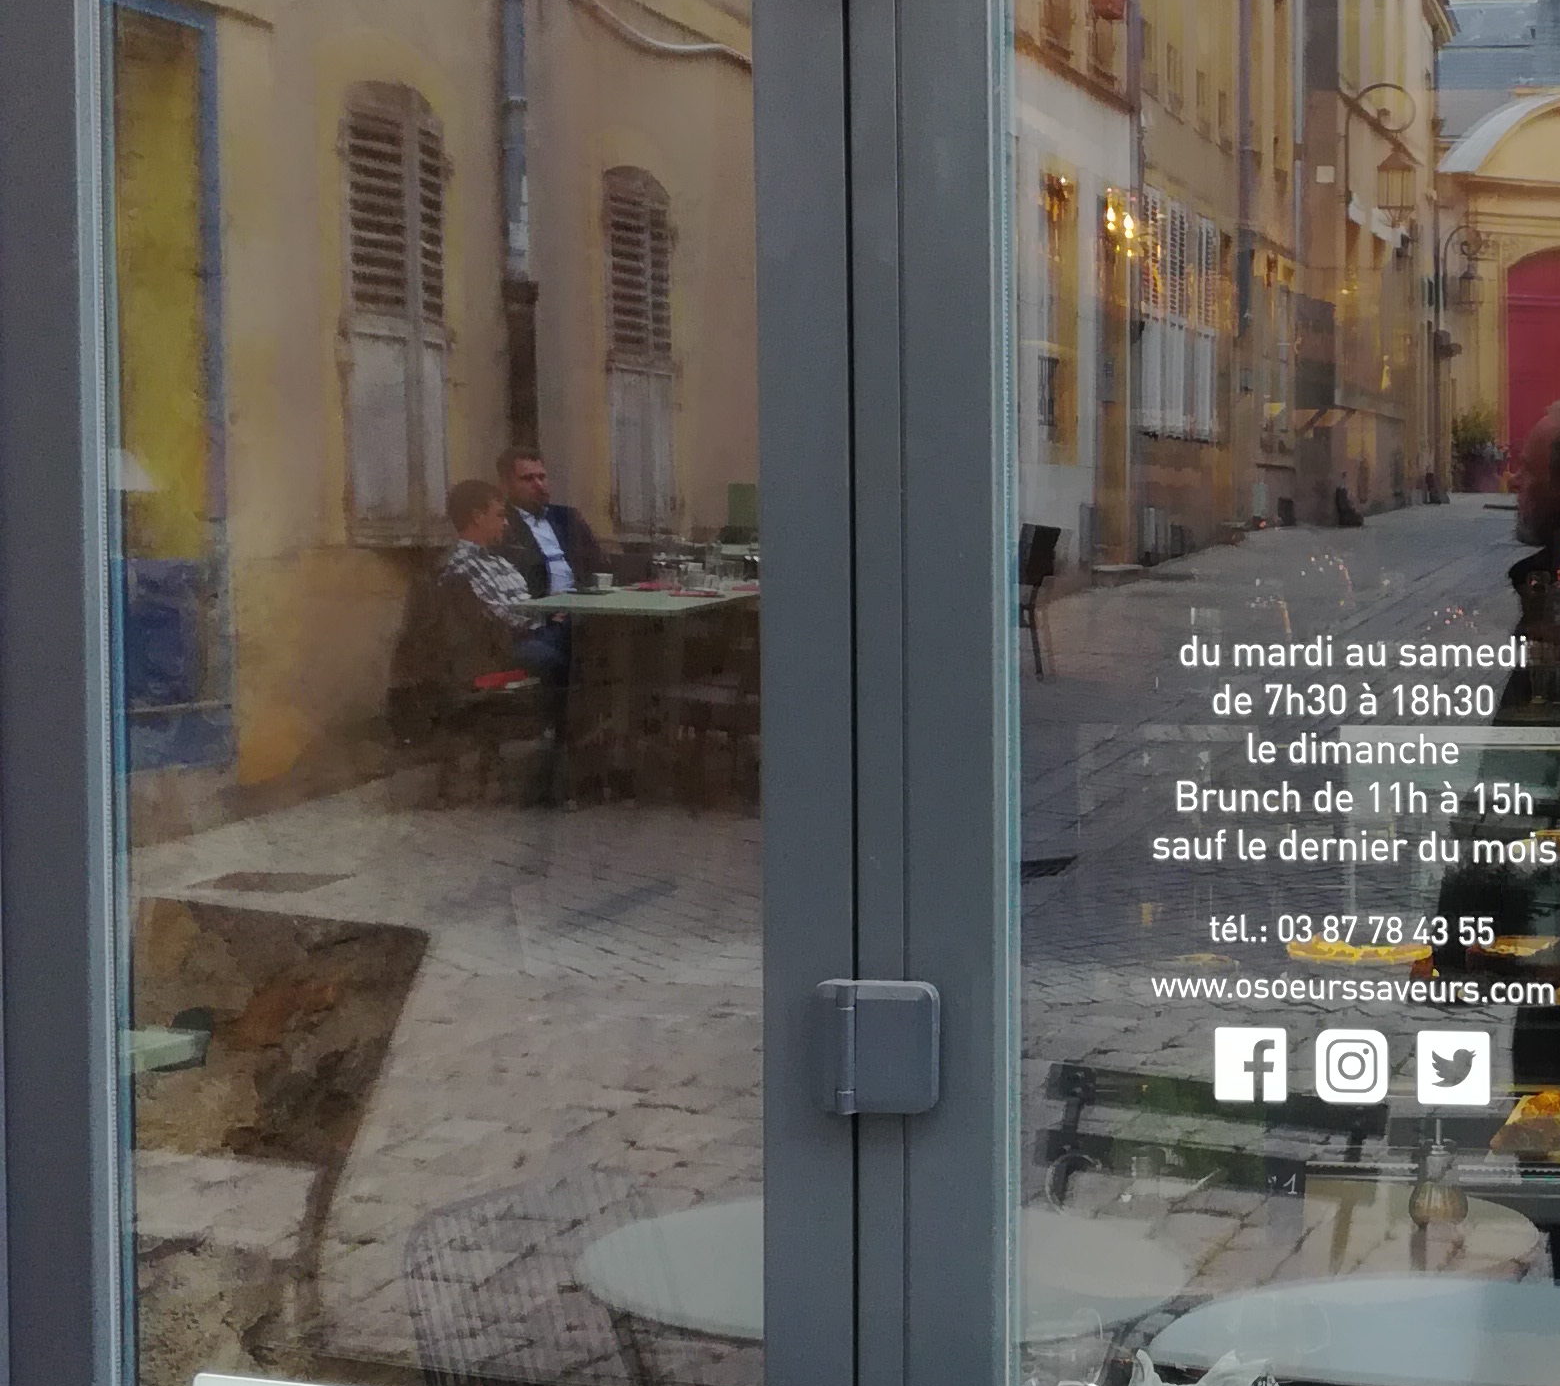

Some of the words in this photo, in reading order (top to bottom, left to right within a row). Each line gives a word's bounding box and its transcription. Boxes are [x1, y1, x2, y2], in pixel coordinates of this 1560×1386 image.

[1180, 635, 1220, 667] du
[1234, 635, 1333, 667] mardi
[1346, 644, 1386, 667] au
[1399, 635, 1527, 668] samedi
[1213, 683, 1253, 715] de
[1265, 683, 1346, 715] 7h30
[1359, 682, 1377, 715] à
[1392, 684, 1494, 716] 18h30
[1247, 732, 1276, 764] le
[1288, 732, 1459, 765] dimanche
[1176, 780, 1301, 813] Brunch
[1314, 780, 1354, 813] de
[1369, 781, 1427, 813] 11h
[1440, 780, 1458, 814] à
[1473, 782, 1533, 815] 15h
[1153, 829, 1227, 860] sauf
[1238, 829, 1267, 860] le
[1279, 829, 1408, 862] dernier
[1418, 830, 1459, 863] du
[1473, 831, 1557, 864] mois
[1209, 914, 1267, 944] tél.:
[1278, 914, 1312, 943] 03
[1323, 915, 1358, 943] 87
[1368, 915, 1403, 944] 78
[1412, 916, 1448, 945] 43
[1459, 916, 1494, 945] 55
[1151, 977, 1557, 1005] www.osoeurssaveurs.com
